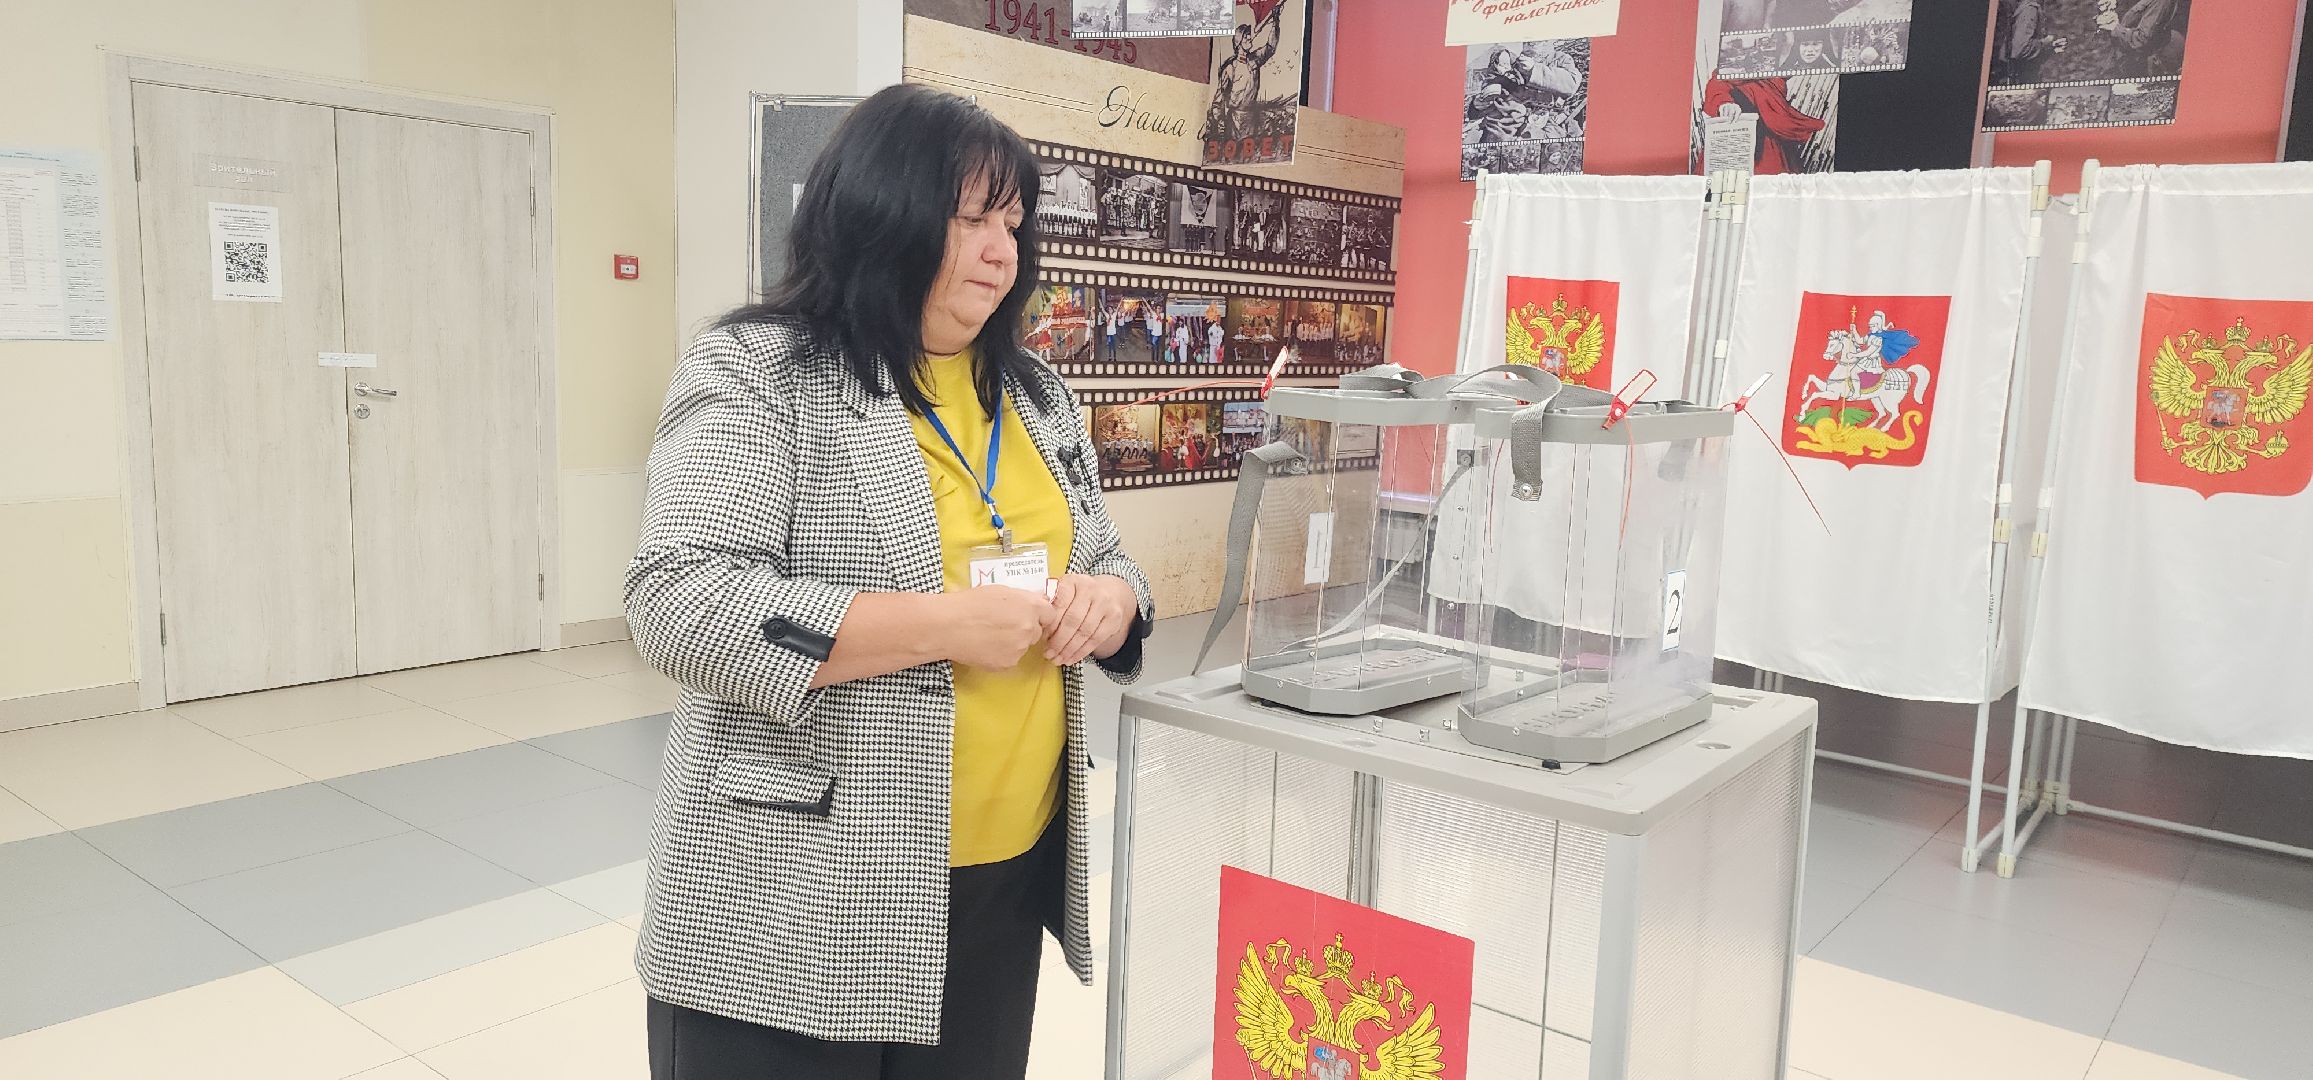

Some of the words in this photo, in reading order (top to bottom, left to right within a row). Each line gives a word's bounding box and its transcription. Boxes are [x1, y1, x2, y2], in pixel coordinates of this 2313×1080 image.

[1097, 85, 1188, 138] Наша
[1206, 134, 1293, 161] ЗОВЕТ
[1667, 589, 1681, 635] 2
